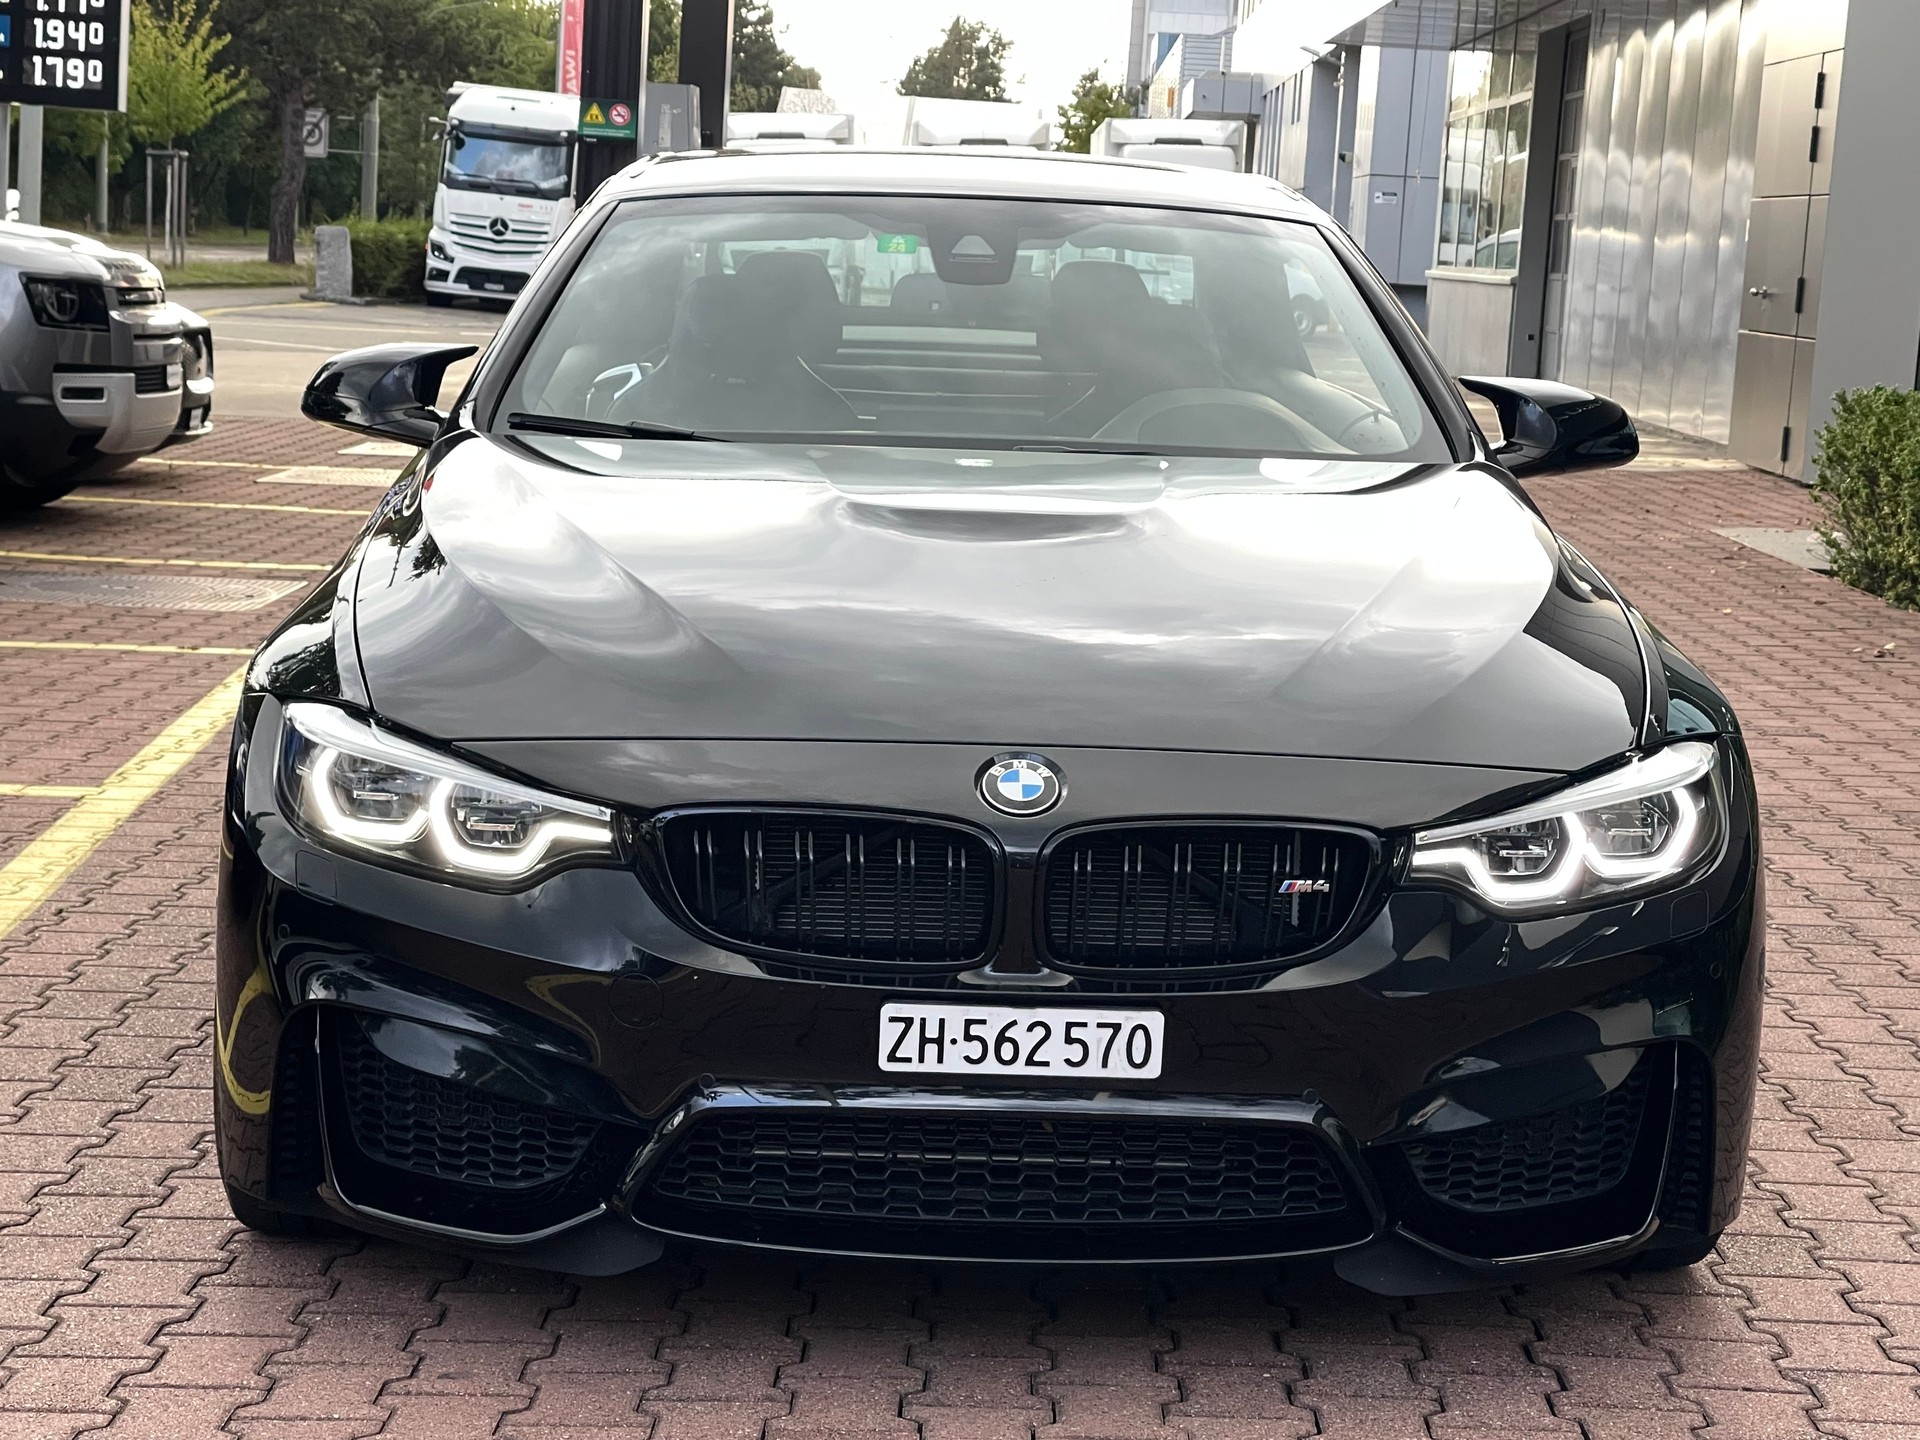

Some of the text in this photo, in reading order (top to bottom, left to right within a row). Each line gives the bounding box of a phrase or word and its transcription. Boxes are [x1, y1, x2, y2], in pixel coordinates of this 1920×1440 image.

[33, 17, 104, 52] 1.940
[32, 55, 103, 89] 1.790
[990, 761, 1052, 778] BMW
